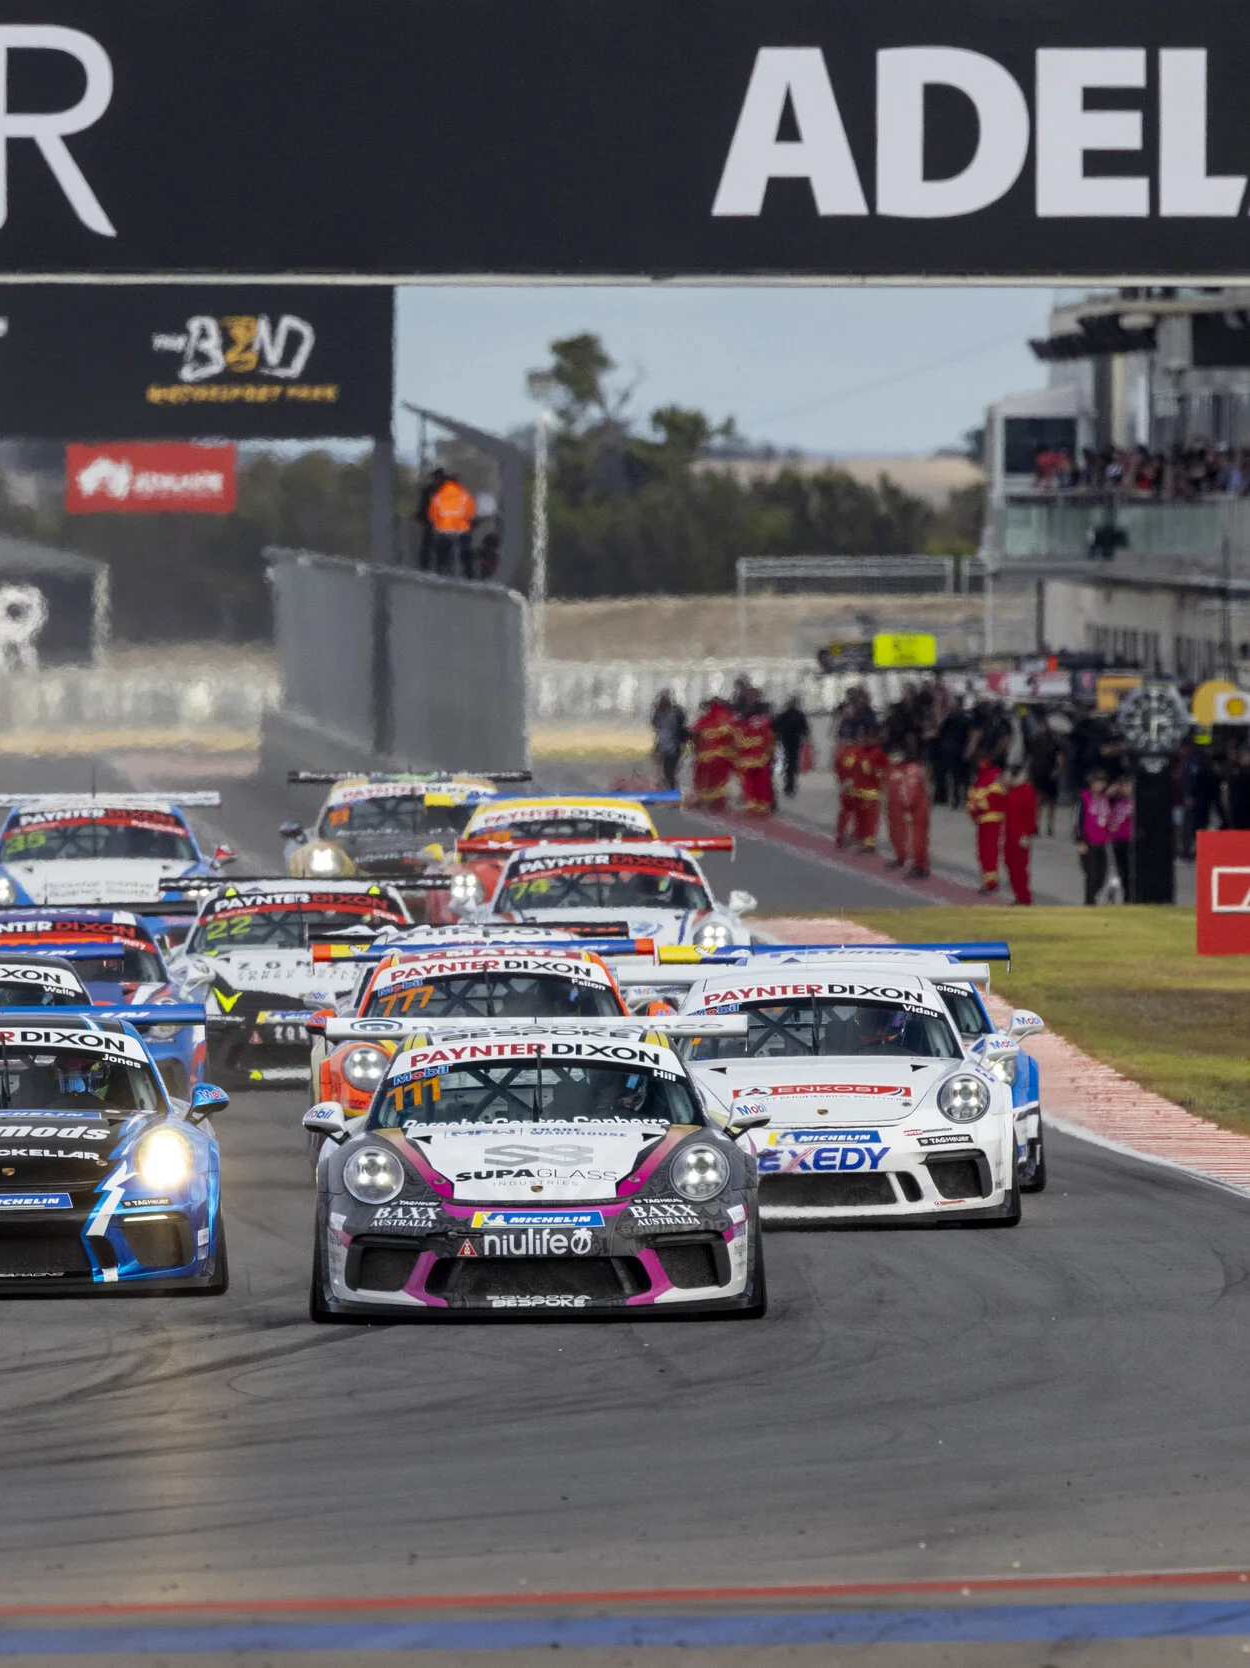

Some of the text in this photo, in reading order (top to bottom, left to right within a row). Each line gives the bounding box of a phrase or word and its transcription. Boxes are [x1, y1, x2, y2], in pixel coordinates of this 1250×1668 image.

[711, 46, 1250, 218] ADEL
[19, 808, 106, 826] PAYNTER
[484, 807, 638, 825] PAYNTER DIXON
[518, 854, 685, 874] PAYNTER DIXON
[509, 878, 549, 900] 74
[214, 893, 311, 913] PAYNTER
[311, 893, 389, 911] DIXON
[54, 920, 136, 939] DIXON
[205, 915, 252, 941] 22
[112, 935, 147, 950] Emery
[390, 960, 592, 982] PAYNTER DIXON
[378, 985, 435, 1018] 777
[703, 983, 924, 1006] PAYNTER DIXON
[902, 1003, 939, 1018] Vidau
[20, 1031, 125, 1053] DIXON
[441, 1029, 641, 1042] BESPOKE
[101, 1053, 141, 1069] Jones
[410, 1043, 661, 1068] PAYNTER DIXON
[393, 1063, 450, 1087] Mobil
[653, 1069, 677, 1083] Hill
[386, 1076, 442, 1112] 111
[798, 1134, 871, 1142] MICHELIN
[758, 1146, 892, 1172] EXEDY
[492, 1180, 580, 1188] INDUSTRIES
[373, 1207, 443, 1221] BAXX
[509, 1214, 592, 1225] MICHELIN
[628, 1203, 700, 1219] BAXX
[369, 1218, 434, 1229] AUSTRALIA
[636, 1216, 702, 1227] AUSTRALIA
[483, 1227, 570, 1256] niulife
[491, 1299, 587, 1309] BESPOKE
